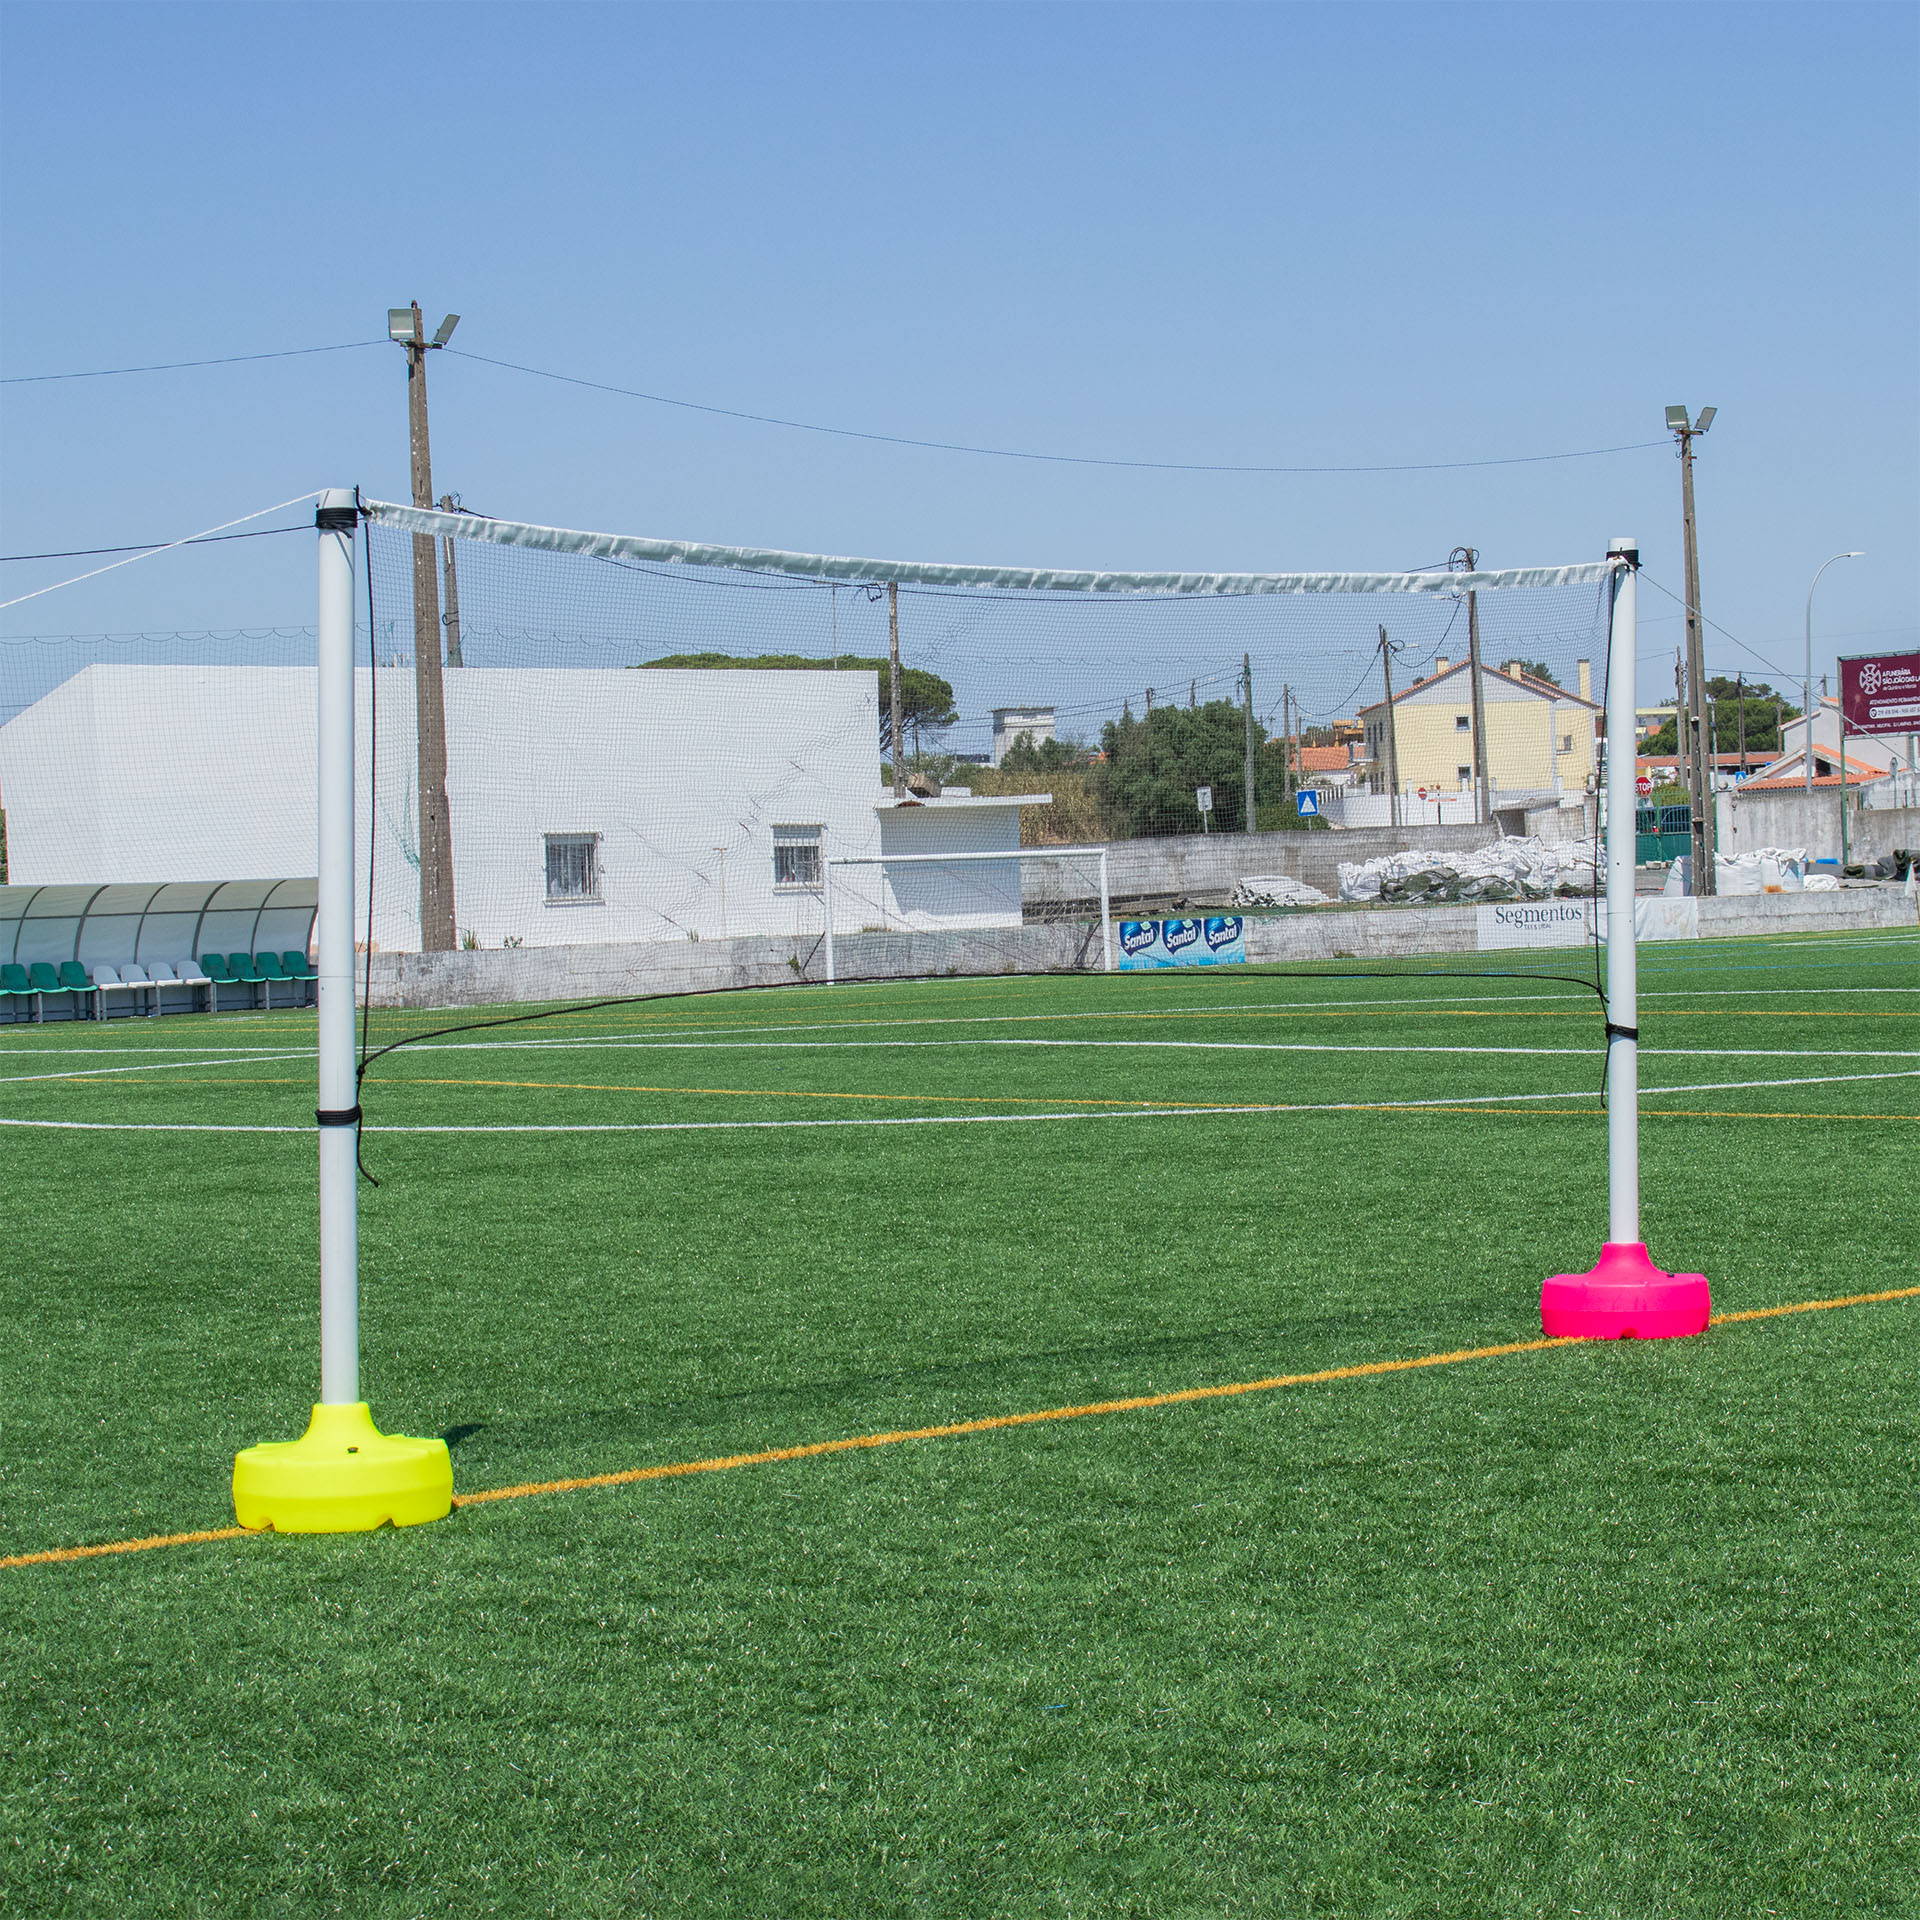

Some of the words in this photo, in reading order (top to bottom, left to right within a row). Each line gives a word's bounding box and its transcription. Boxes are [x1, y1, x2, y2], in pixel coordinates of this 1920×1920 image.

[1635, 783, 1651, 792] STOP
[1495, 904, 1582, 928] Segmentos
[1124, 929, 1154, 950] Santal
[1166, 926, 1196, 948] Santal
[1208, 924, 1237, 946] Santal
